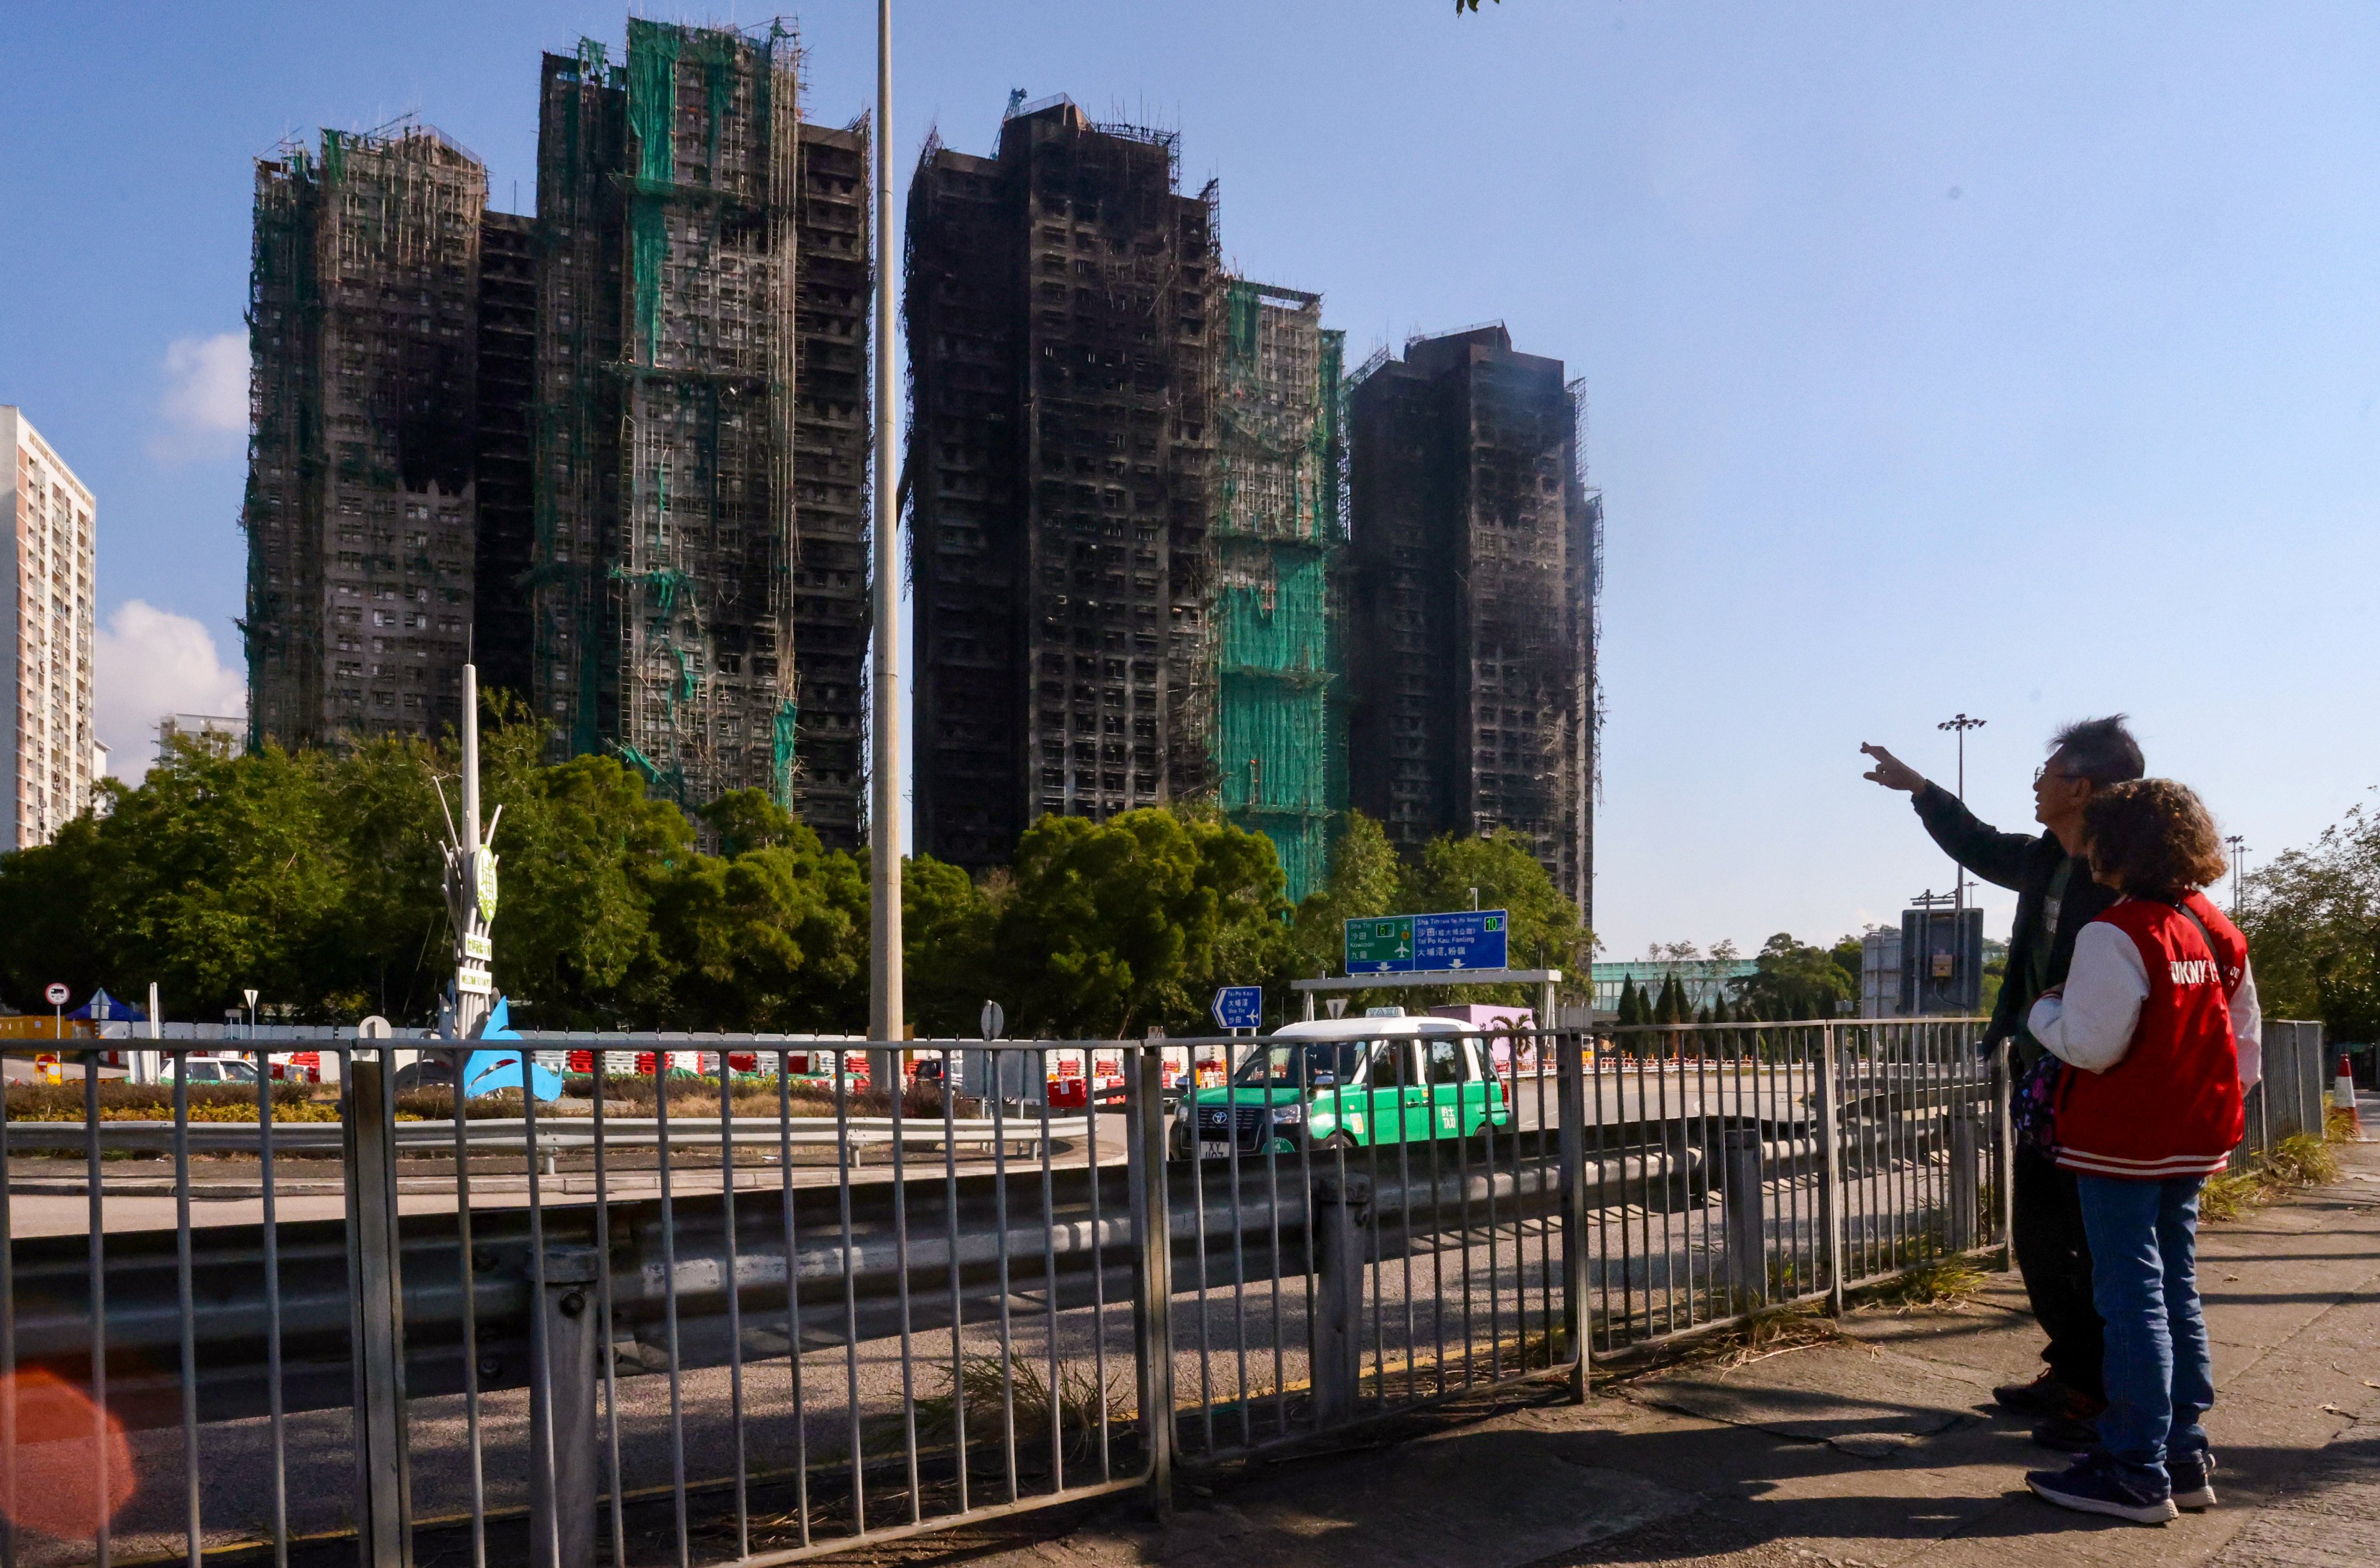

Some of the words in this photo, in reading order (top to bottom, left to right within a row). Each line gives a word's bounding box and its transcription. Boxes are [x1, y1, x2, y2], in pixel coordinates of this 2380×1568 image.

[1487, 918, 1497, 930] 10
[1380, 924, 1385, 936] 6
[1350, 932, 1367, 941] 沙田
[1351, 950, 1367, 960] 九龍
[2170, 960, 2206, 984] DKNY
[1228, 999, 1249, 1007] 大埔滘
[1368, 1008, 1399, 1016] TAXI
[1228, 1016, 1242, 1024] 沙田
[1441, 1105, 1455, 1117] 的士
[1442, 1117, 1456, 1129] TAXI
[1209, 1142, 1221, 1152] XY
